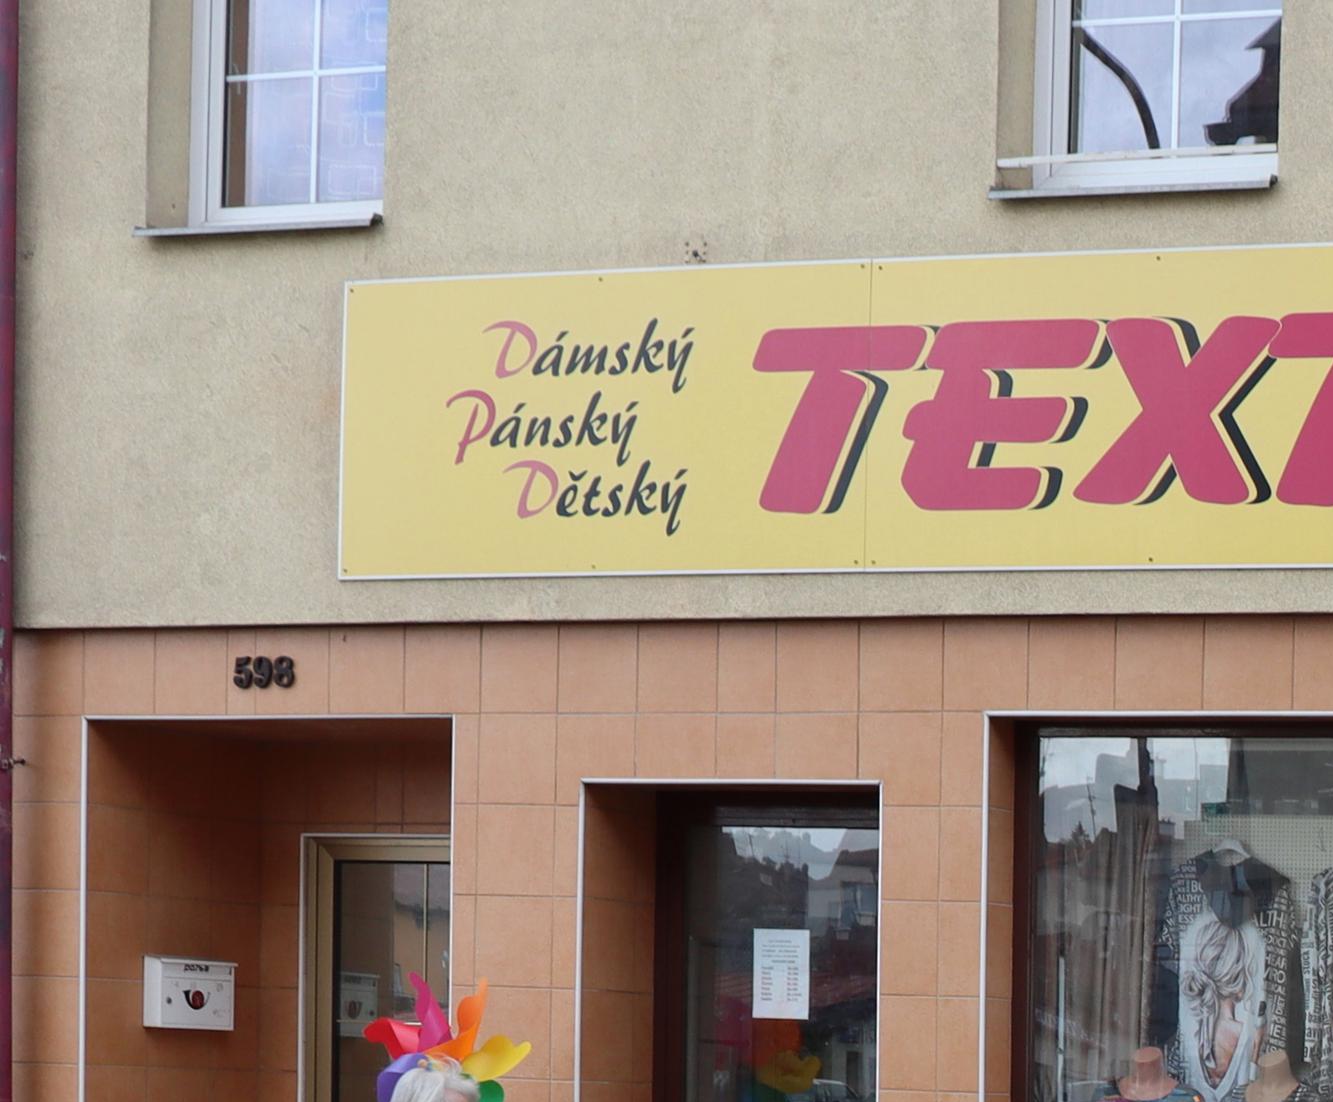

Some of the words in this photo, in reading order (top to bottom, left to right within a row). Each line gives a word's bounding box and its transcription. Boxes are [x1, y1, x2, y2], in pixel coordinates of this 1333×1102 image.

[482, 318, 694, 393] Dámský
[446, 389, 639, 465] Pánský
[504, 459, 688, 537] Dětský
[233, 655, 295, 689] 598
